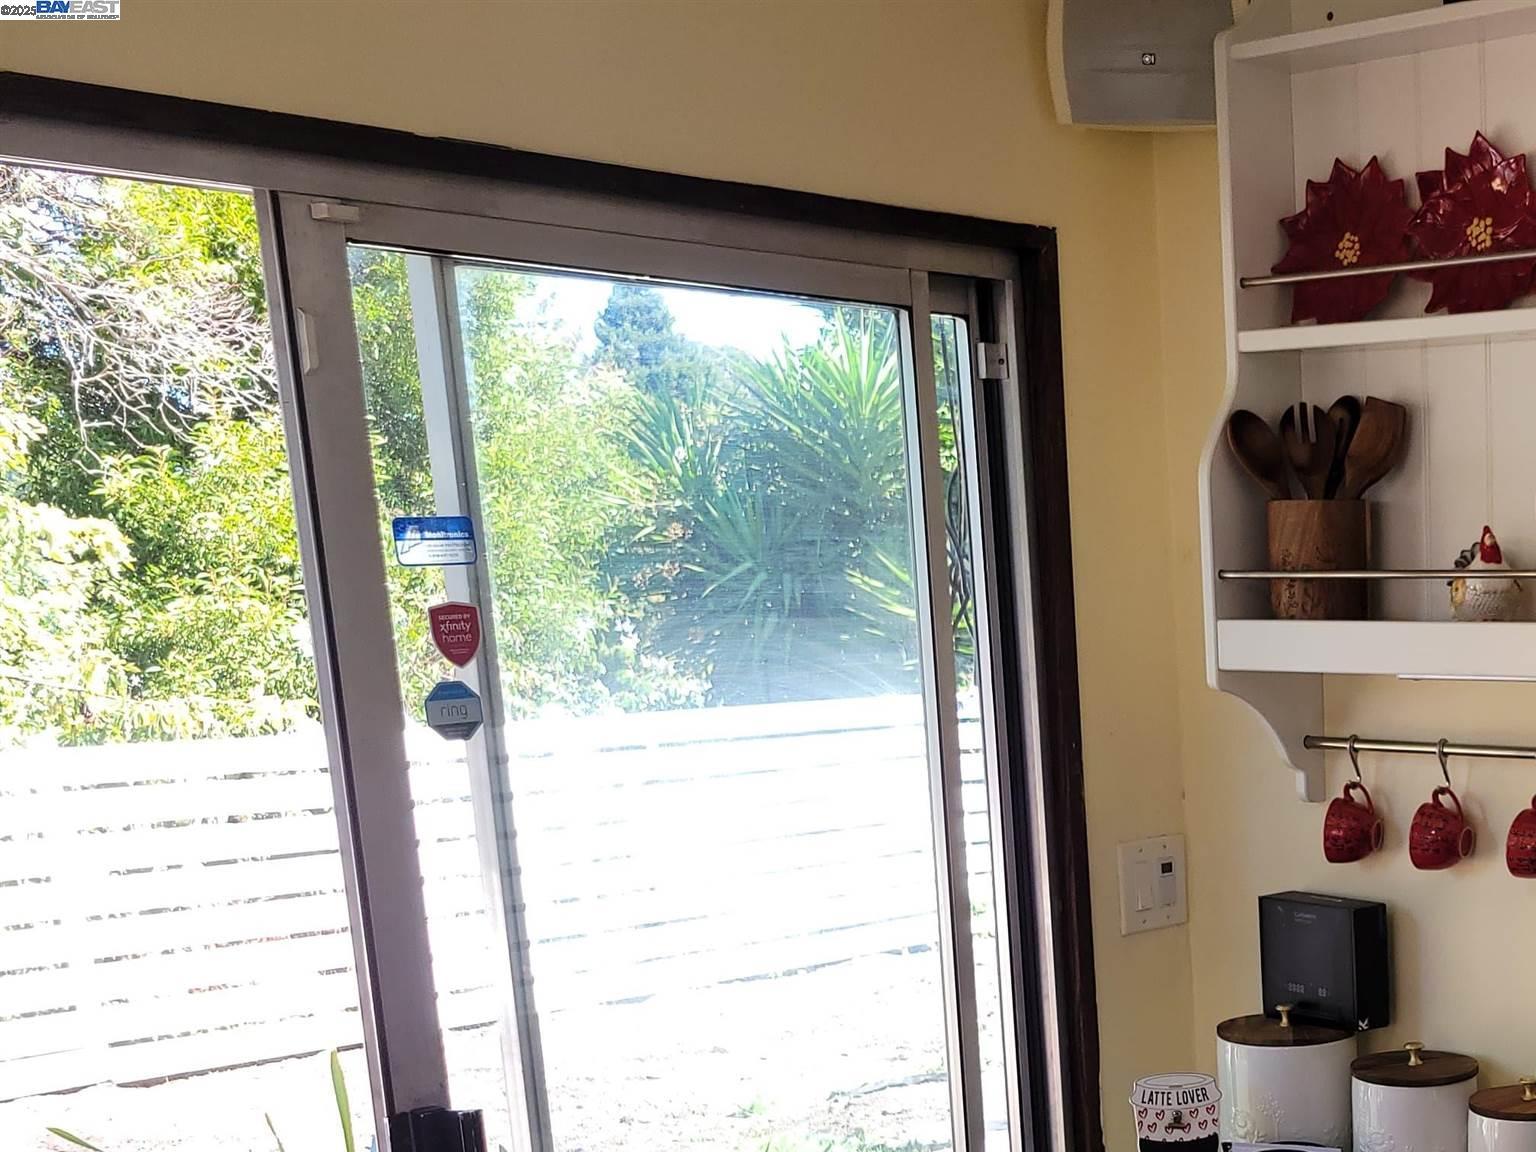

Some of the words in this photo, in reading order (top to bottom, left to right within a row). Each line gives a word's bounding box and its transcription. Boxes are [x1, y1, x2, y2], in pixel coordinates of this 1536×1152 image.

[440, 620, 471, 633] xfinity
[442, 633, 472, 642] home
[440, 703, 468, 720] ring
[1141, 1089, 1172, 1106] LATTE
[1176, 1087, 1210, 1106] LOVER
